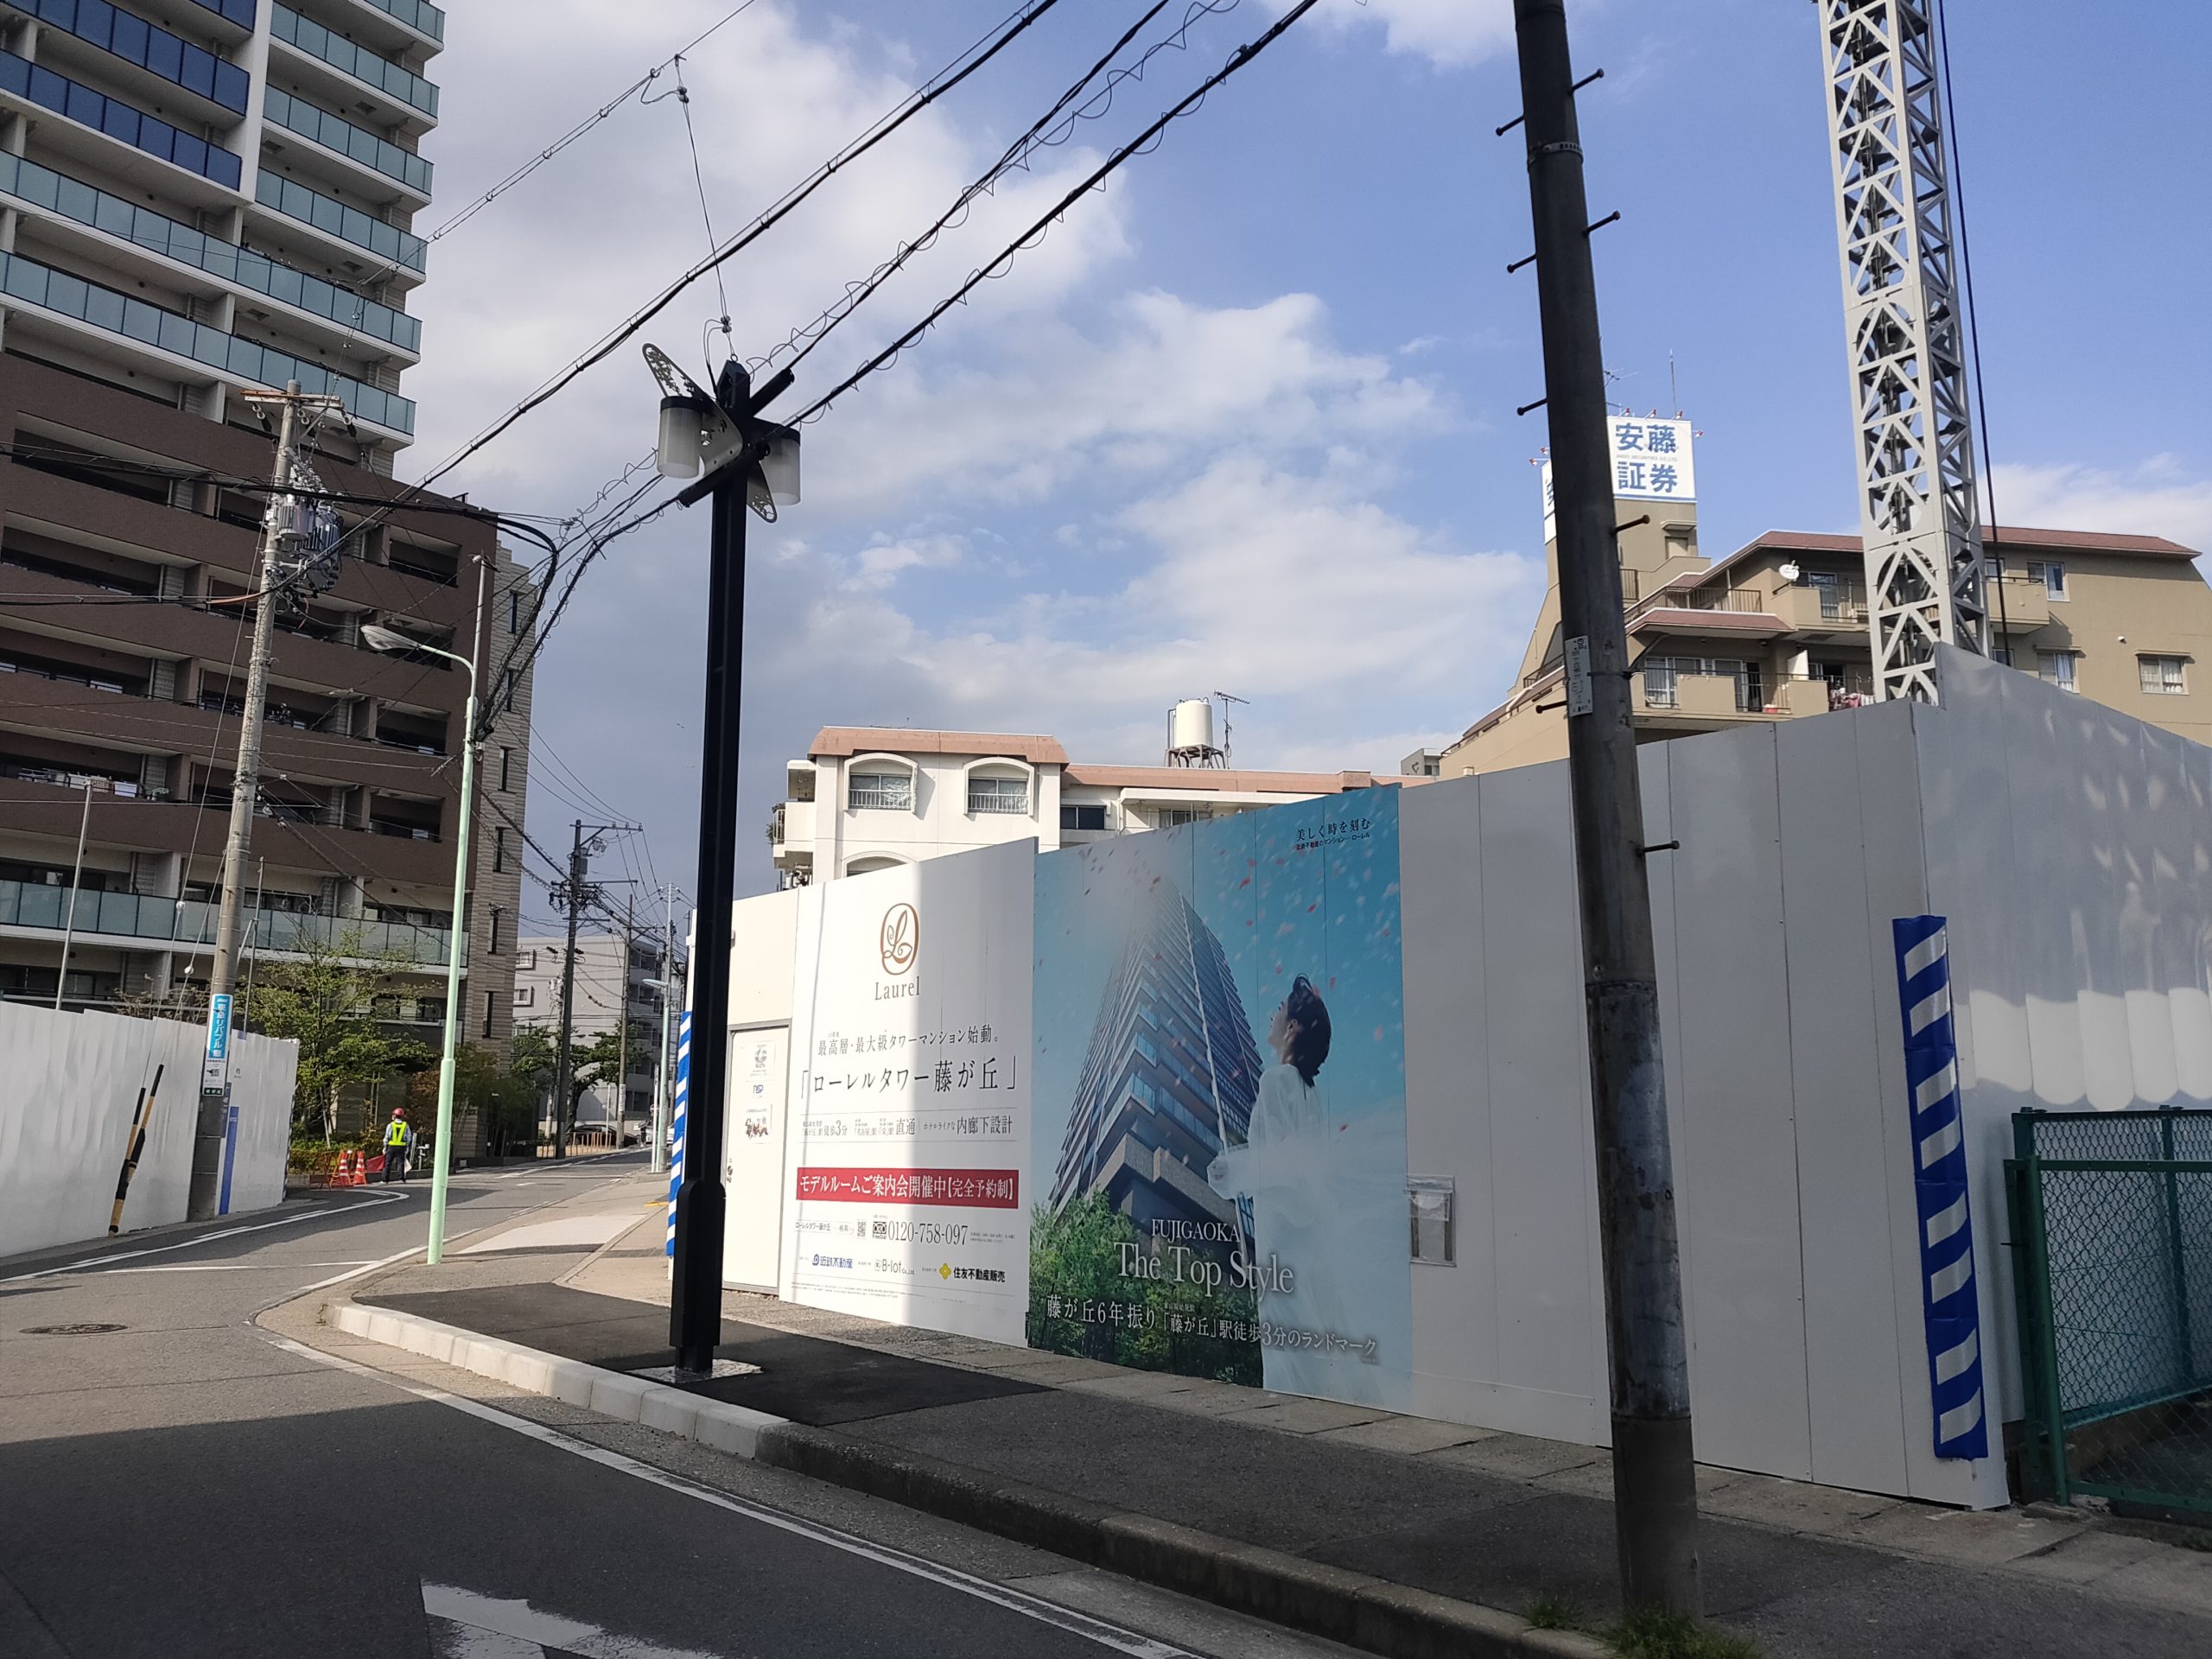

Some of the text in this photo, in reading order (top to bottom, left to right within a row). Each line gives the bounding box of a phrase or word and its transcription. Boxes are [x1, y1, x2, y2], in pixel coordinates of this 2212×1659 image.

[1615, 423, 1677, 454] 安藤
[1617, 461, 1678, 493] 証券
[1295, 817, 1370, 842] 美しく時を刻む
[874, 976, 920, 1001] Laurel
[801, 1055, 1017, 1099] 「ローレルタワー藤が丘」
[799, 1173, 1014, 1200] モデルルームご案内会開催中【完全予約制】
[888, 1220, 969, 1246] 0120-758-097
[1151, 1218, 1241, 1243] FUJIGAOKA
[820, 1255, 853, 1268] 近鉄不動産
[1113, 1242, 1294, 1301] The Top Style
[953, 1267, 1006, 1283] 住友不動産販売
[1046, 1294, 1377, 1356] 藤が丘6年振り 「藤が丘」駅徒歩3分のランドマーク
